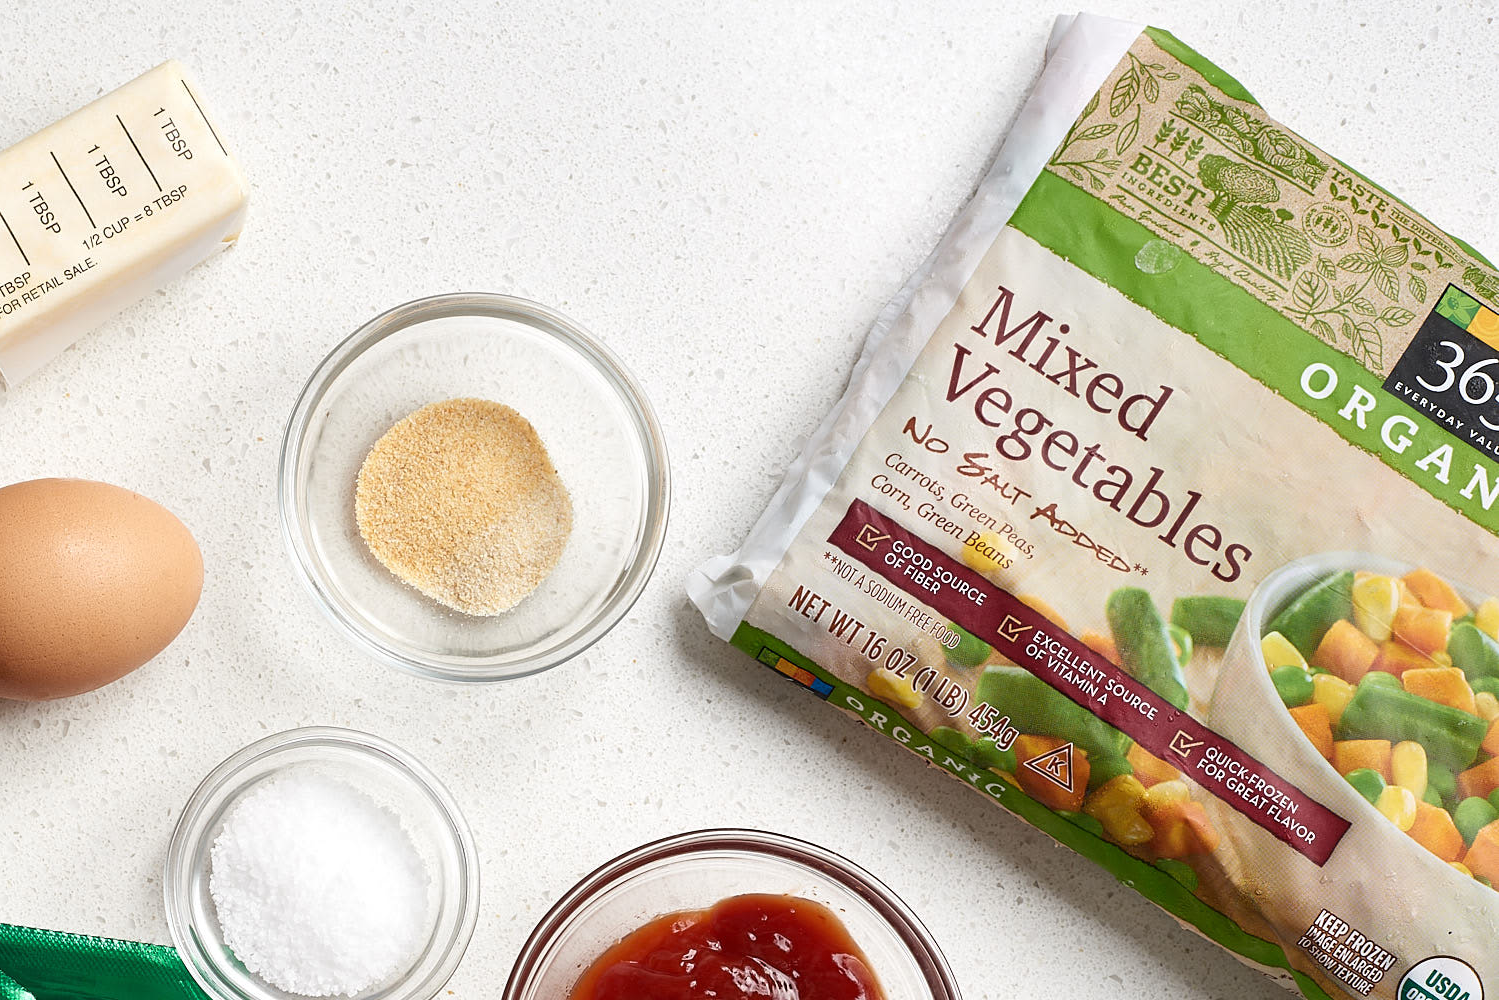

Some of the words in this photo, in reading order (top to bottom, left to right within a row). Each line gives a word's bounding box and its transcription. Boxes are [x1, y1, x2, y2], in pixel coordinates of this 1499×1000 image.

[154, 107, 165, 118] 1
[161, 117, 193, 162] TBSP
[87, 144, 100, 155] 1
[95, 154, 128, 199] TBSP
[1121, 172, 1216, 232] INGREDIENTS
[1130, 153, 1206, 206] BEST
[1331, 168, 1390, 213] TASTE
[1390, 209, 1410, 225] THE
[22, 181, 34, 192] 1
[29, 191, 61, 236] TBSP
[82, 231, 103, 251] 1/2
[102, 216, 131, 240] CUP
[143, 205, 154, 218] 8
[152, 184, 189, 212] TBSP
[22, 276, 64, 305] RETAIL
[64, 257, 99, 281] SALE.
[970, 285, 1174, 442] Mixed
[1394, 381, 1465, 430] EVERYDAY
[946, 342, 1252, 582] Vegetables
[956, 452, 1032, 506] SALT
[870, 474, 911, 510] Corn,
[917, 502, 968, 541] Green
[962, 530, 1013, 570] Beans
[884, 452, 944, 501] Carrots,
[950, 493, 1004, 530] Green
[998, 520, 1038, 560] Peas,
[884, 552, 906, 571] OF
[903, 564, 941, 596] FIBER
[891, 540, 933, 571] GOOD
[932, 566, 988, 606] SOURCE
[856, 574, 866, 589] A
[864, 578, 907, 614] SODIUM
[904, 605, 932, 632] FREE
[930, 621, 961, 650] FOOD
[788, 585, 832, 624] NET
[827, 608, 866, 646] WT
[861, 630, 888, 662] 16
[884, 648, 917, 680] OZ
[910, 665, 938, 694] (1
[934, 678, 970, 718] LB)
[968, 702, 1020, 752] 454g
[1025, 644, 1046, 660] OF
[1046, 658, 1100, 698] VITAMIN
[1097, 694, 1108, 706] A
[1032, 630, 1106, 684] EXCELLENT
[1104, 679, 1158, 721] SOURCE
[846, 696, 1006, 798] ORGANIC
[1196, 758, 1224, 784] FOR
[1226, 777, 1270, 810] GREAT
[1266, 806, 1316, 844] FLAVOR
[1204, 746, 1299, 815] QUICK-FROZEN
[1298, 936, 1312, 948] TO
[1308, 944, 1335, 970] SHOW
[1334, 964, 1374, 996] TEXTURE
[1306, 926, 1338, 954] IMAGE
[1332, 943, 1384, 984] ENLARGED
[1314, 909, 1349, 938] KEEP
[1344, 928, 1397, 972] FROZEN
